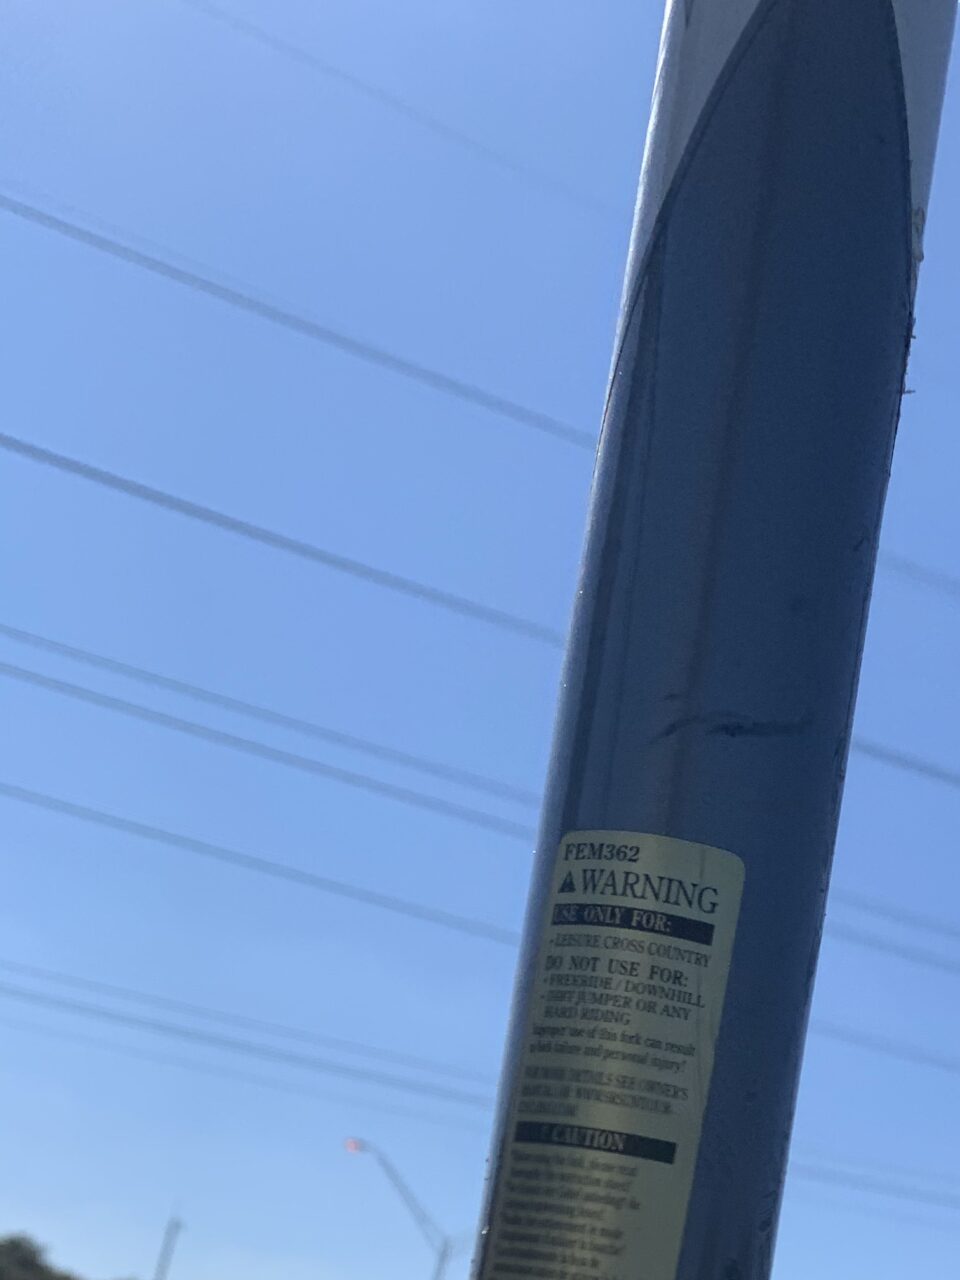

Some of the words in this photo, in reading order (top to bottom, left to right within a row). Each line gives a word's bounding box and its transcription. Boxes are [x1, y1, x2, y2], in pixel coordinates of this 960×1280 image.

[563, 843, 641, 863] FEM362
[582, 868, 719, 914] WARNING
[584, 905, 625, 926] ONLY
[631, 910, 672, 932] FOR:
[603, 935, 645, 954] CROSS
[647, 942, 712, 968] COUNTRY
[545, 955, 563, 972] DO
[568, 955, 601, 973] NOT
[608, 958, 641, 978] USE
[650, 964, 689, 988] FOR:
[624, 981, 706, 1009] DOWNHILL
[636, 1000, 658, 1015] OR
[659, 1004, 692, 1021] ANY
